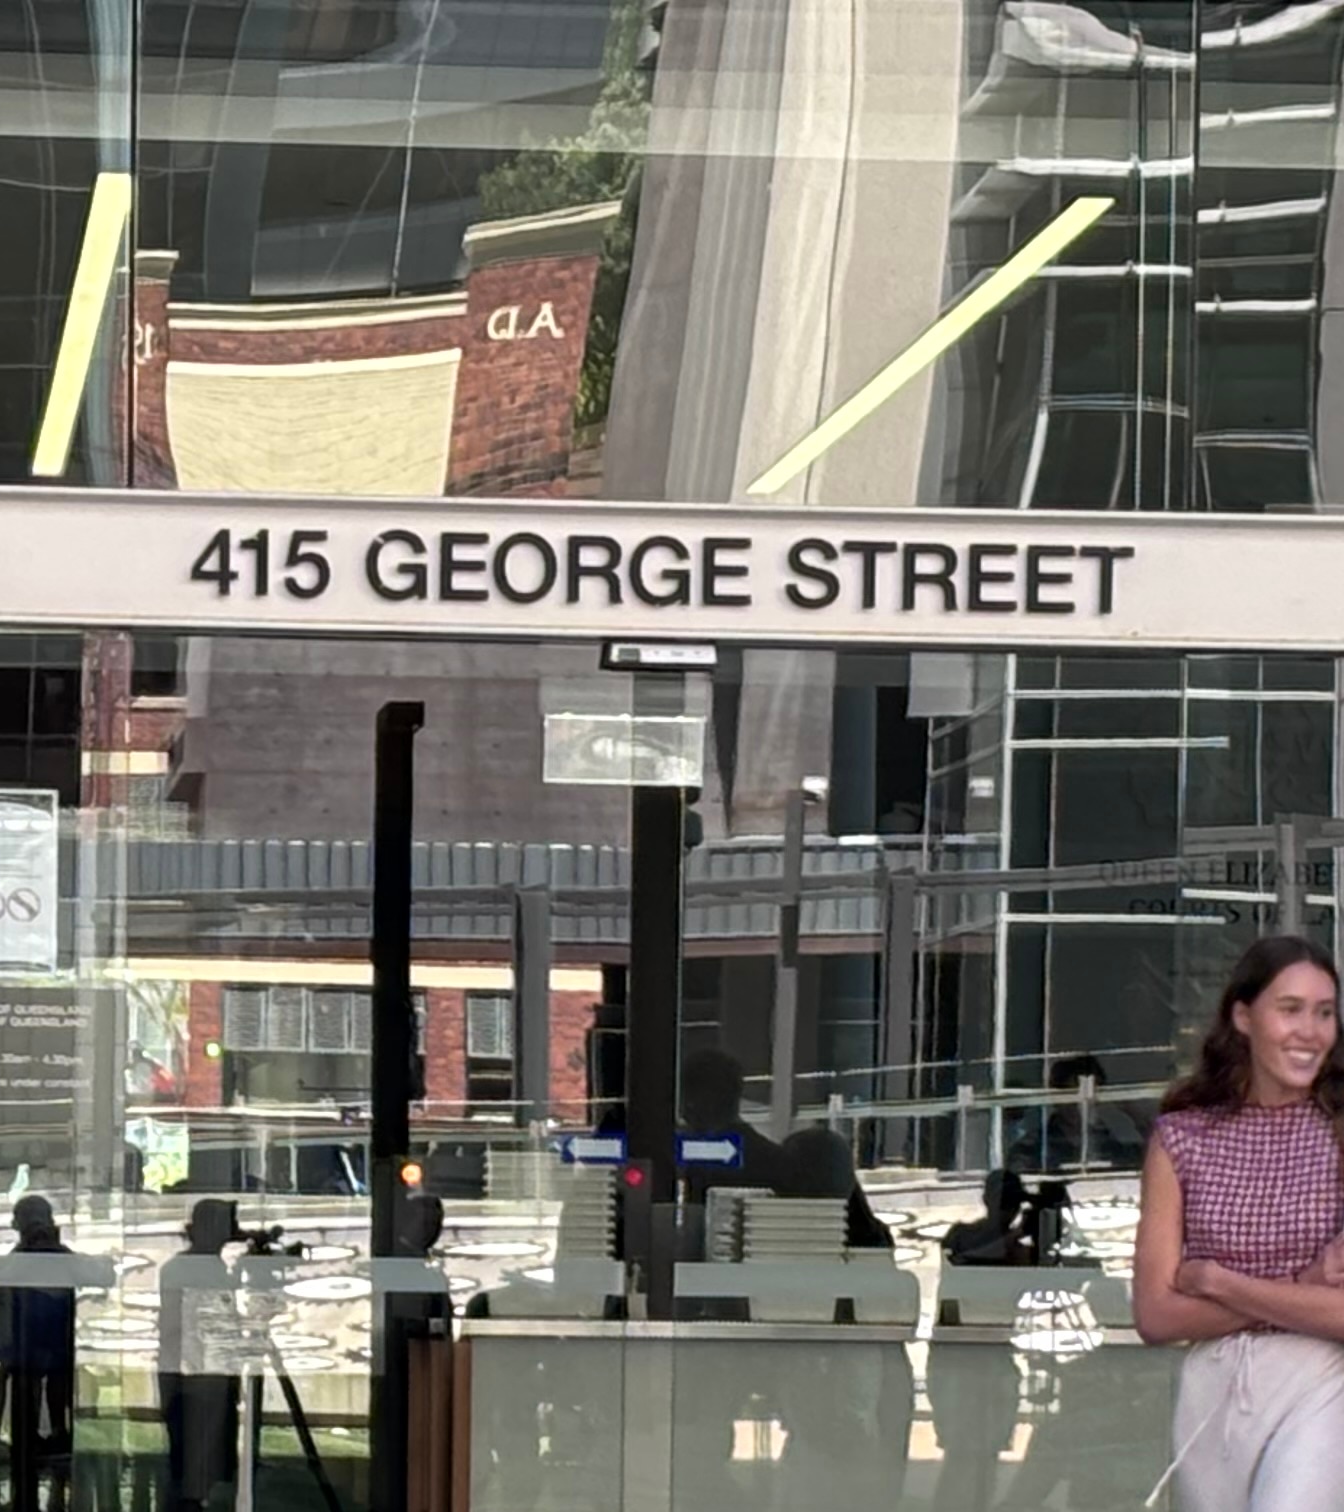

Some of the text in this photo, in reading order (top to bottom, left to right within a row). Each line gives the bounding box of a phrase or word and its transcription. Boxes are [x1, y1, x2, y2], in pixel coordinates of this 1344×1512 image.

[191, 529, 1134, 615] 415 GEORGE STREET
[14, 1004, 91, 1016] QUEENSLAND
[10, 1016, 88, 1028] QUEENSLAND
[10, 1077, 41, 1087] under
[44, 1078, 90, 1088] constant
